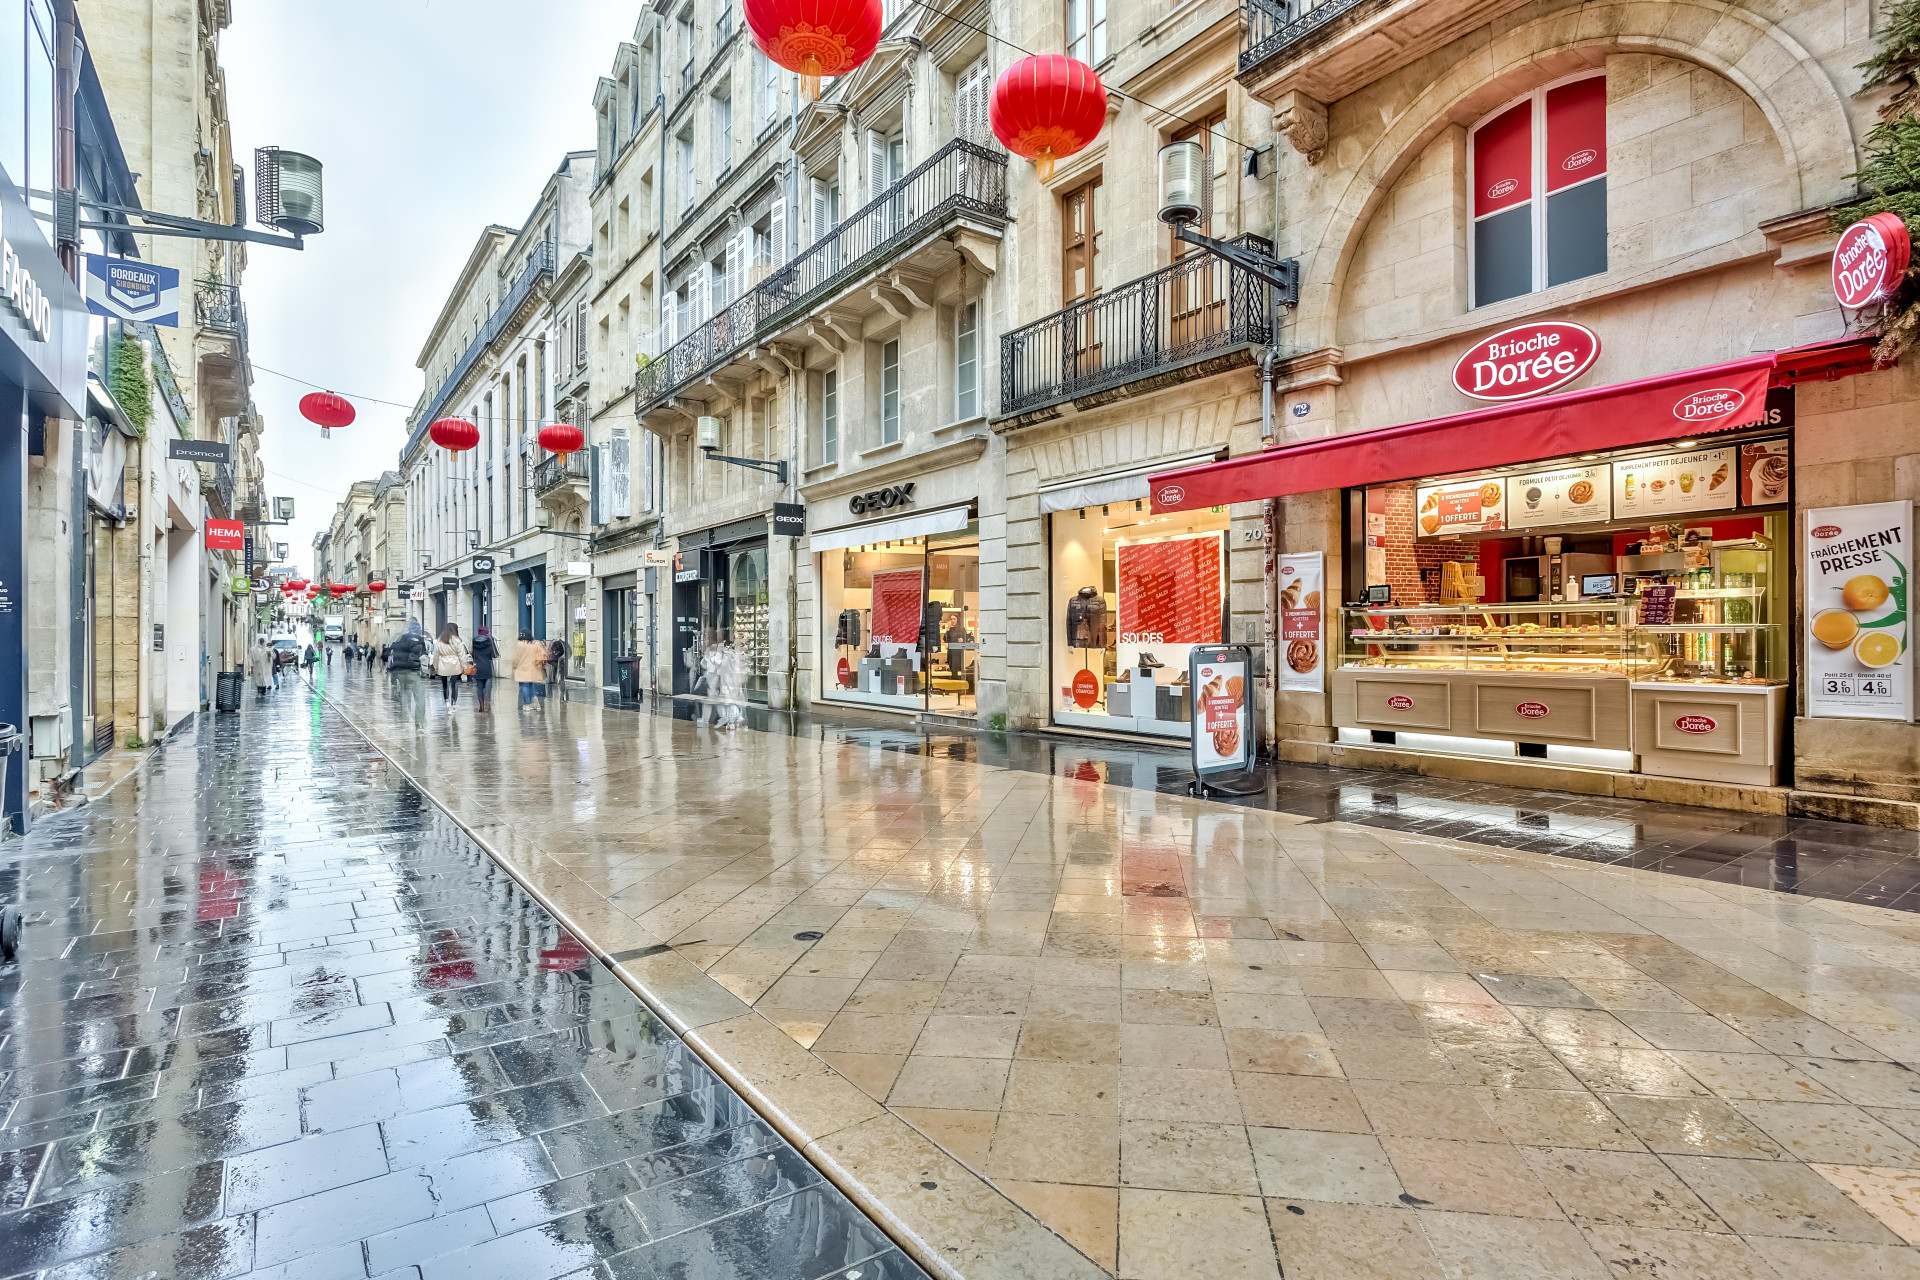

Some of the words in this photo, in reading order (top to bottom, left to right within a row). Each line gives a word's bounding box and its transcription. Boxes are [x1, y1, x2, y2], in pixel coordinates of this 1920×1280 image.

[1567, 155, 1592, 168] Dorée
[1492, 184, 1514, 196] Dorée
[1838, 234, 1868, 270] Brioche
[110, 267, 156, 285] BORDEAUX
[1838, 248, 1884, 302] Dorée
[2, 236, 51, 344] FAGUO
[116, 280, 151, 292] GIRONDINS
[1488, 332, 1560, 360] Brioche
[1473, 350, 1576, 392] Dorée
[1692, 392, 1728, 405] Brioche
[1684, 400, 1735, 418] Dorée
[176, 450, 224, 458] promod
[1670, 454, 1708, 465] DEJEUNER
[1519, 477, 1543, 486] FORMULE
[848, 482, 915, 515] GEOX
[1161, 493, 1181, 503] Dorée
[776, 515, 804, 524] GEOX
[209, 528, 241, 538] HEMA
[1245, 528, 1262, 541] 70
[1810, 526, 1902, 560] FRAÎCHEMENT
[1122, 632, 1164, 644] SOLDES
[1391, 700, 1410, 709] Dorée
[1520, 707, 1544, 716] Dorée
[1681, 721, 1711, 730] Dorée
